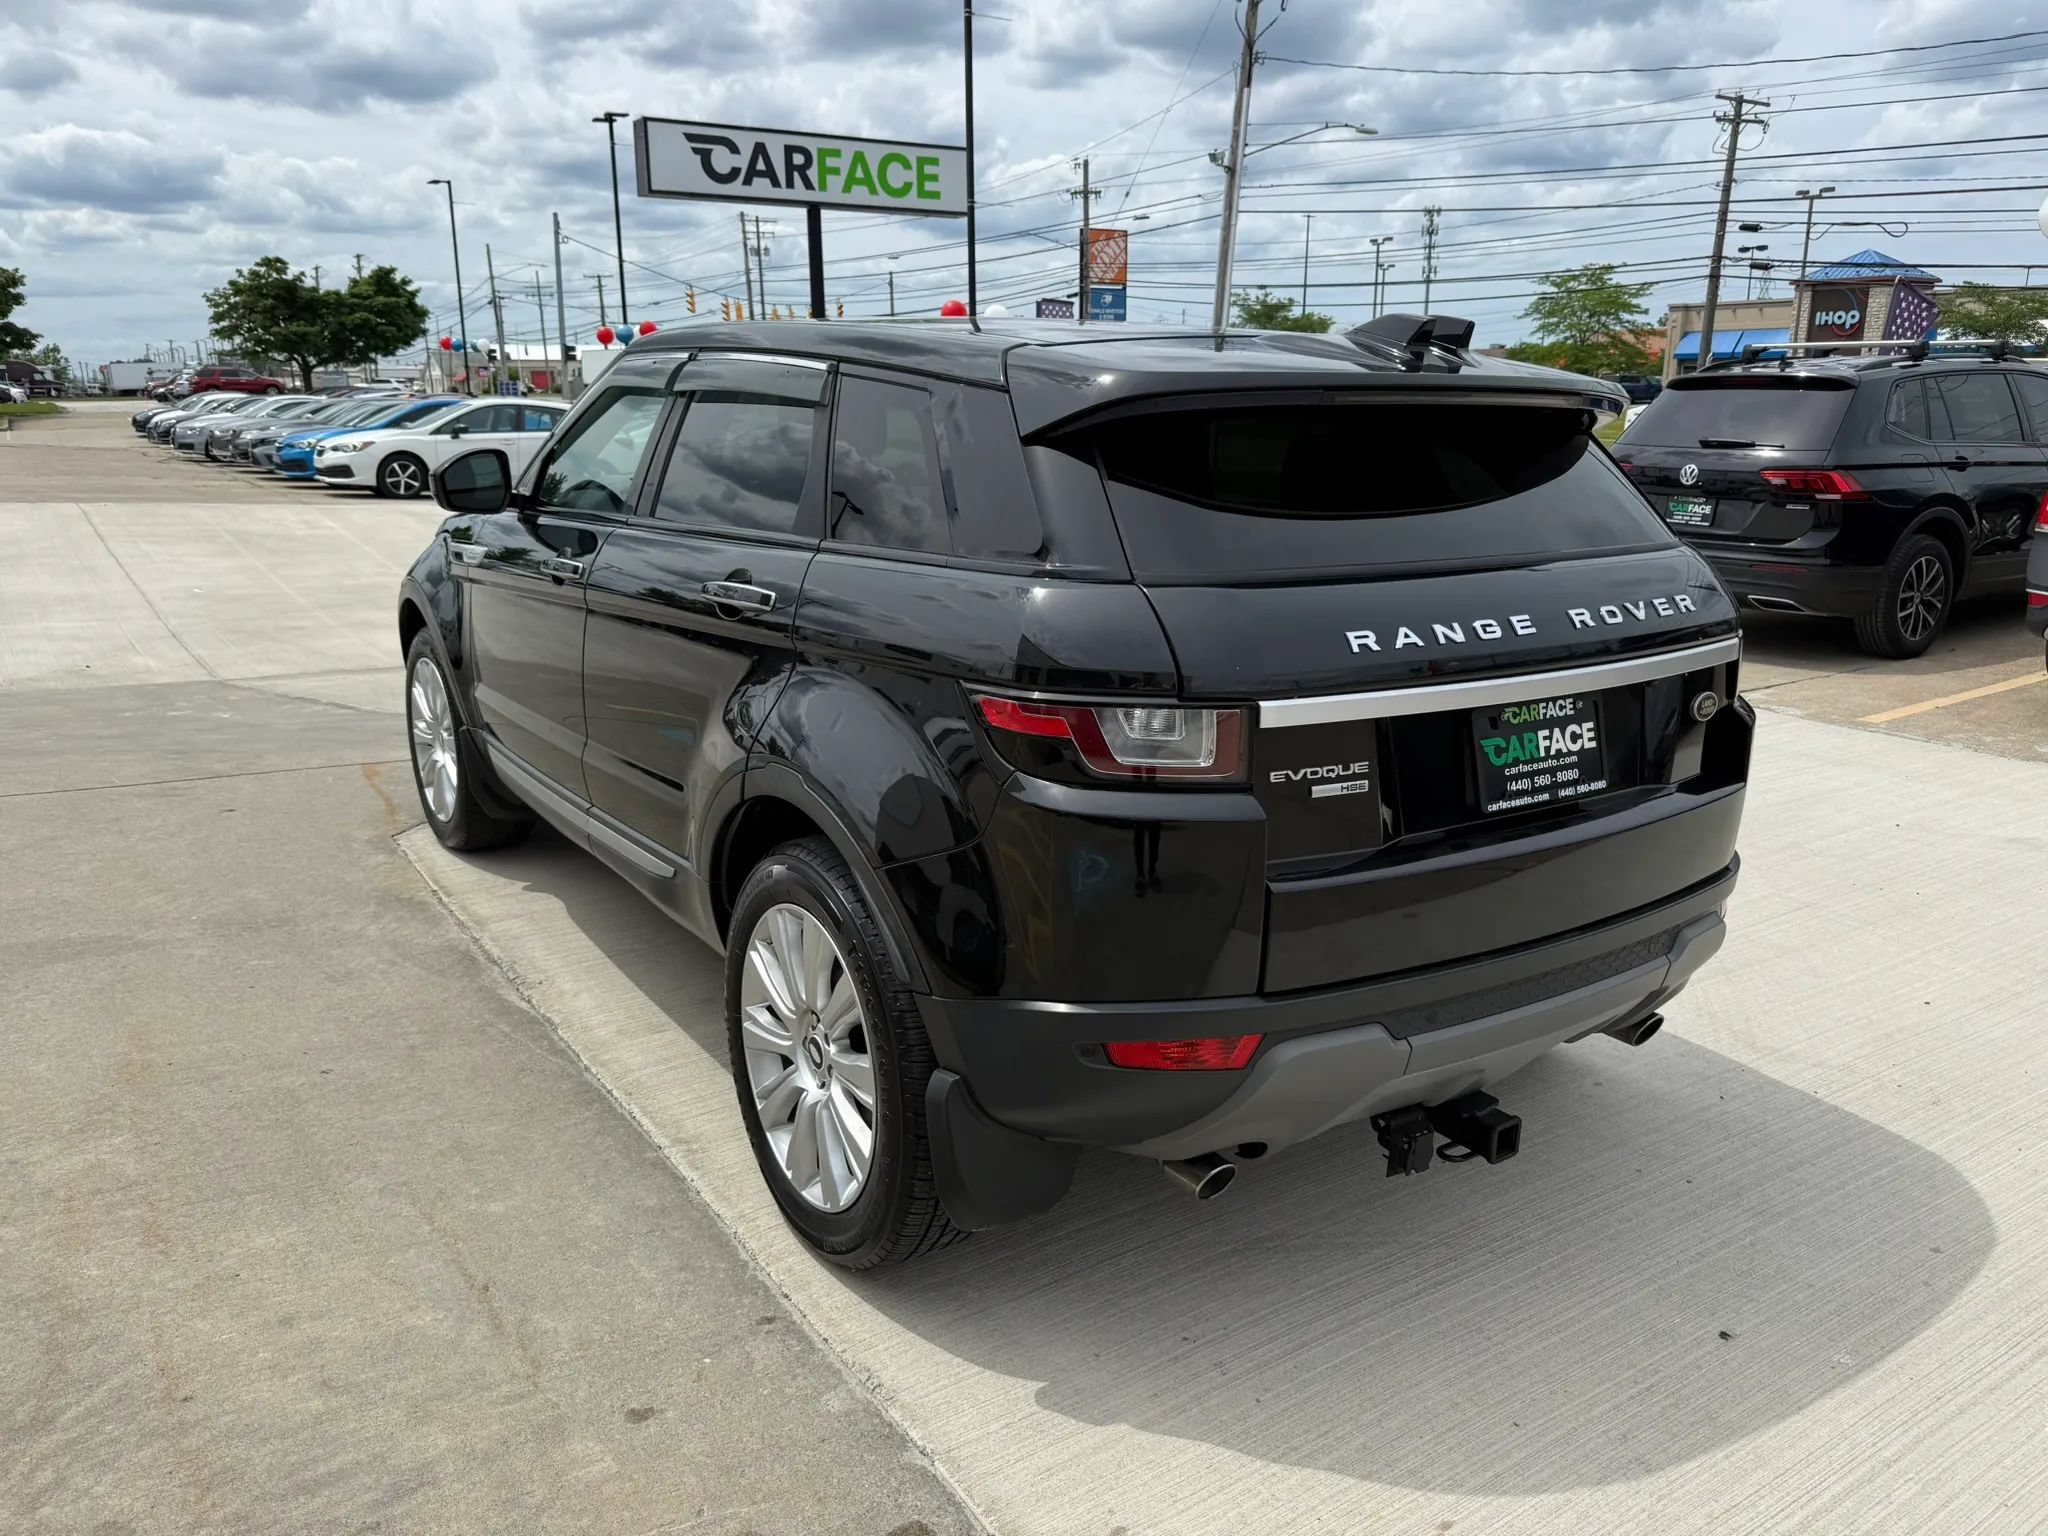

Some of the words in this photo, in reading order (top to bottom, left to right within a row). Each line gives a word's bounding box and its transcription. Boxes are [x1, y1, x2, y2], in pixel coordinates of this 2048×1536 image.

[682, 132, 942, 200] CARFACE
[1815, 310, 1860, 329] IHOP
[1669, 501, 1712, 514] CARFACE
[1345, 614, 1537, 653] RANGE
[1566, 593, 1697, 629] ROVER
[1503, 698, 1575, 725] CARFACE
[1480, 721, 1597, 766] CARFACE
[1269, 761, 1369, 783] EVOQUE
[1504, 755, 1578, 775] carfaceauto.com
[1340, 782, 1367, 793] HSE
[1507, 777, 1532, 791] (440)
[1534, 768, 1579, 787] 560-8080
[1487, 793, 1550, 811] carfaceauto.com
[1558, 786, 1576, 798] (440)
[1576, 780, 1607, 794] 560-8080
